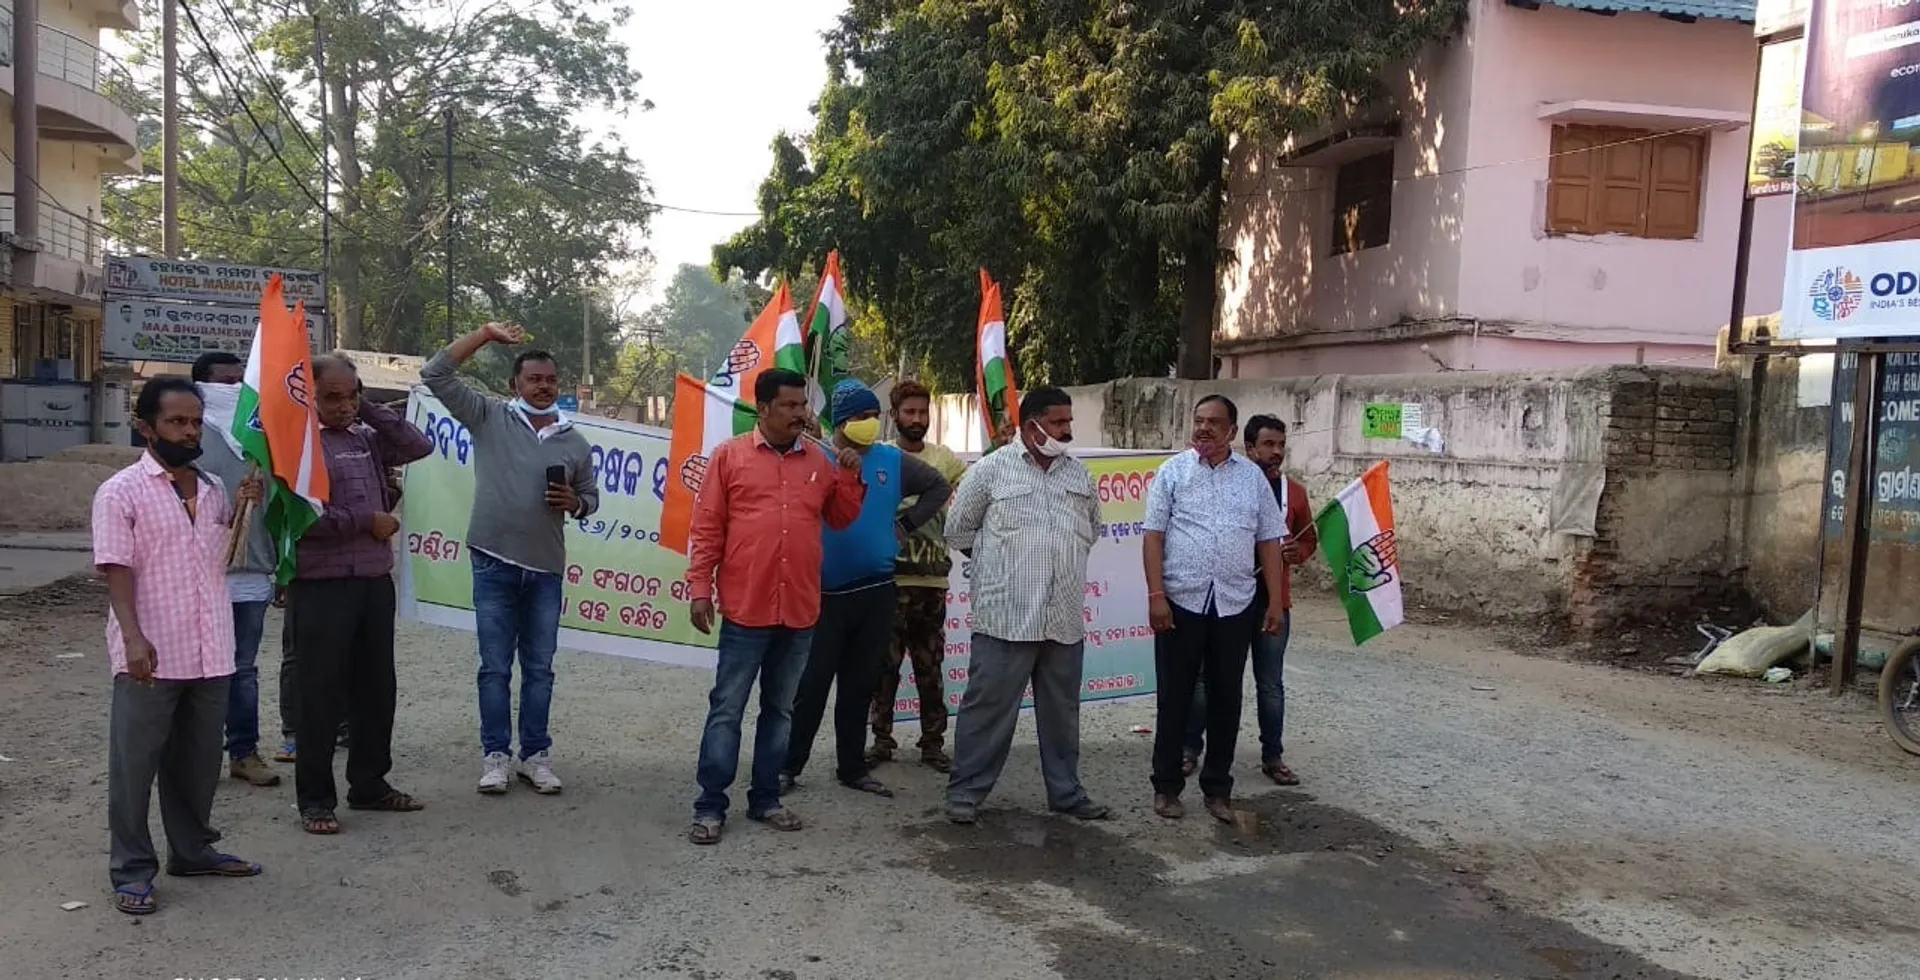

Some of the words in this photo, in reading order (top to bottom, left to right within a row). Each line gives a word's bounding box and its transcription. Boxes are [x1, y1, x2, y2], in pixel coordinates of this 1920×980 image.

[159, 274, 198, 288] HOTEL
[202, 277, 262, 292] MAMATA
[1870, 271, 1920, 297] OD
[142, 321, 169, 333] MAA
[172, 323, 254, 338] BHUBANESW
[593, 568, 661, 597] ସଂଗଠନ
[578, 599, 610, 623] ସହ
